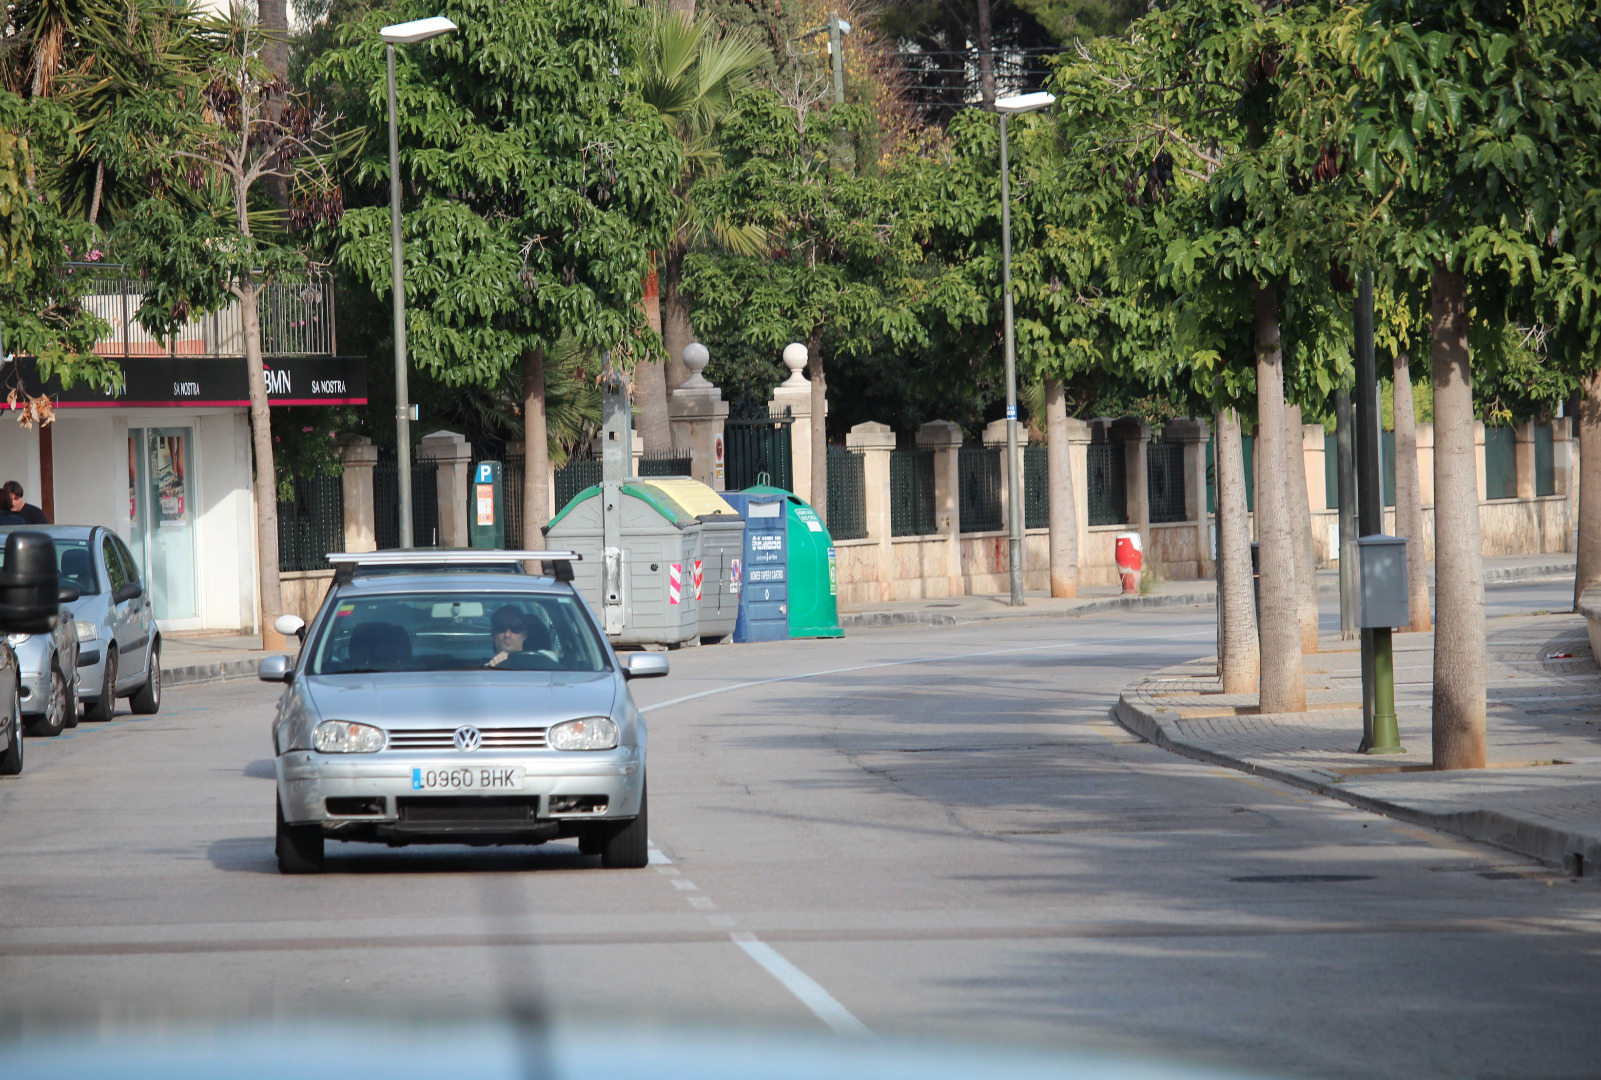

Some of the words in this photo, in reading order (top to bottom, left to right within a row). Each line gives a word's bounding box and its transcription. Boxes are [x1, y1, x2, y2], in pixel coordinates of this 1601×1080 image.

[173, 382, 180, 395] SA
[181, 382, 200, 395] NOSTRA
[263, 370, 291, 394] BMN
[311, 381, 320, 393] SA
[321, 380, 346, 393] NOSTRA
[481, 465, 491, 481] P
[426, 769, 473, 787] 0960
[481, 769, 515, 787] BHK
